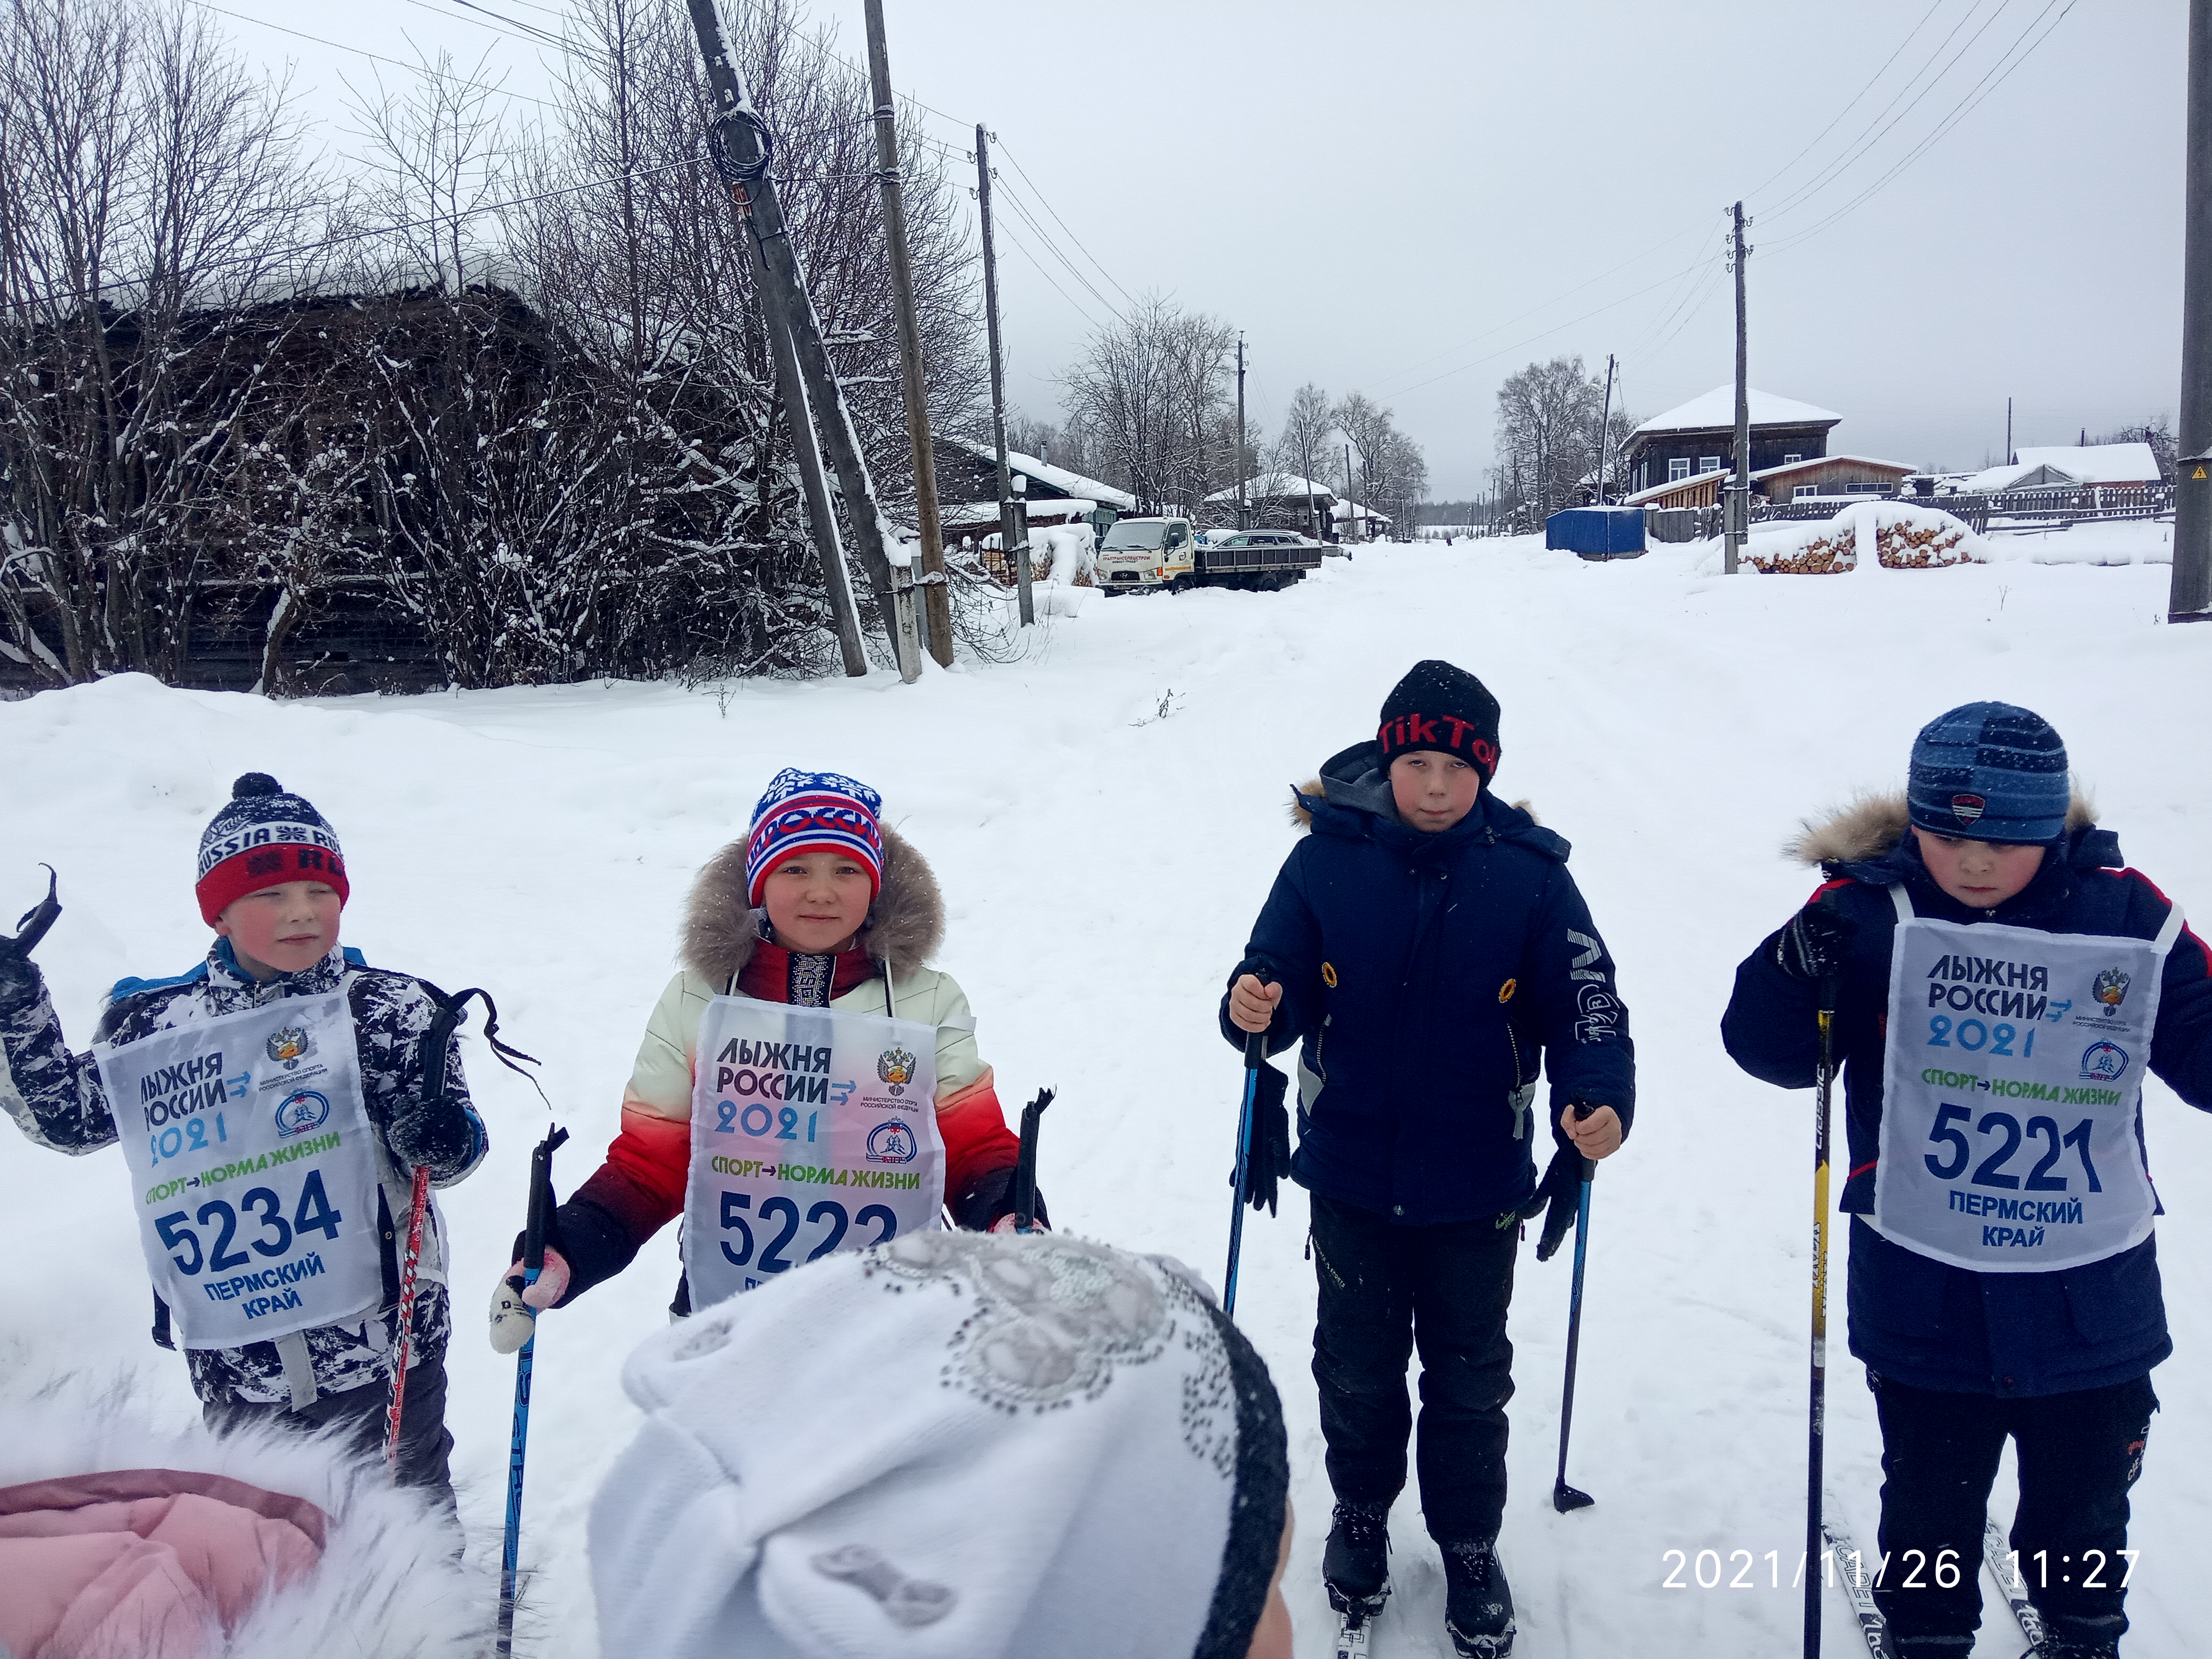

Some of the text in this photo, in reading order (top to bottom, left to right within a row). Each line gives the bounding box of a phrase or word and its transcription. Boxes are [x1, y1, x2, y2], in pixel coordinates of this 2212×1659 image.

[198, 828, 343, 878] RUSSIA RU
[1926, 954, 2049, 992] ЛЫЖНЯ
[1928, 983, 2048, 1021] РОССИИ
[716, 1037, 832, 1074] ЛЫЖНЯ
[1926, 1015, 2035, 1058] 2021
[141, 1052, 222, 1105] ЛЫЖНЯ
[302, 1064, 323, 1073] СПОРТА
[716, 1066, 829, 1104] РОССИИ
[1921, 1068, 2122, 1107] СПОРТ НОРМА ЖИЗНИ
[144, 1078, 228, 1132] РОССИИ
[714, 1100, 818, 1142] 2021
[150, 1111, 227, 1168] 2021
[1924, 1103, 2102, 1193] 5221
[146, 1132, 341, 1204] СПОРТ НОРМА ЖИЗНИ
[711, 1155, 920, 1189] СПОРТ НОРМА ЖИЗНИ
[154, 1170, 341, 1276] 5234
[1949, 1190, 2083, 1224] ПЕРМСКИЙ
[719, 1191, 898, 1273] 5222
[1982, 1225, 2045, 1247] КРАЙ
[204, 1252, 325, 1301] ПЕРМСКИЙ
[241, 1288, 303, 1320] КРАЙ
